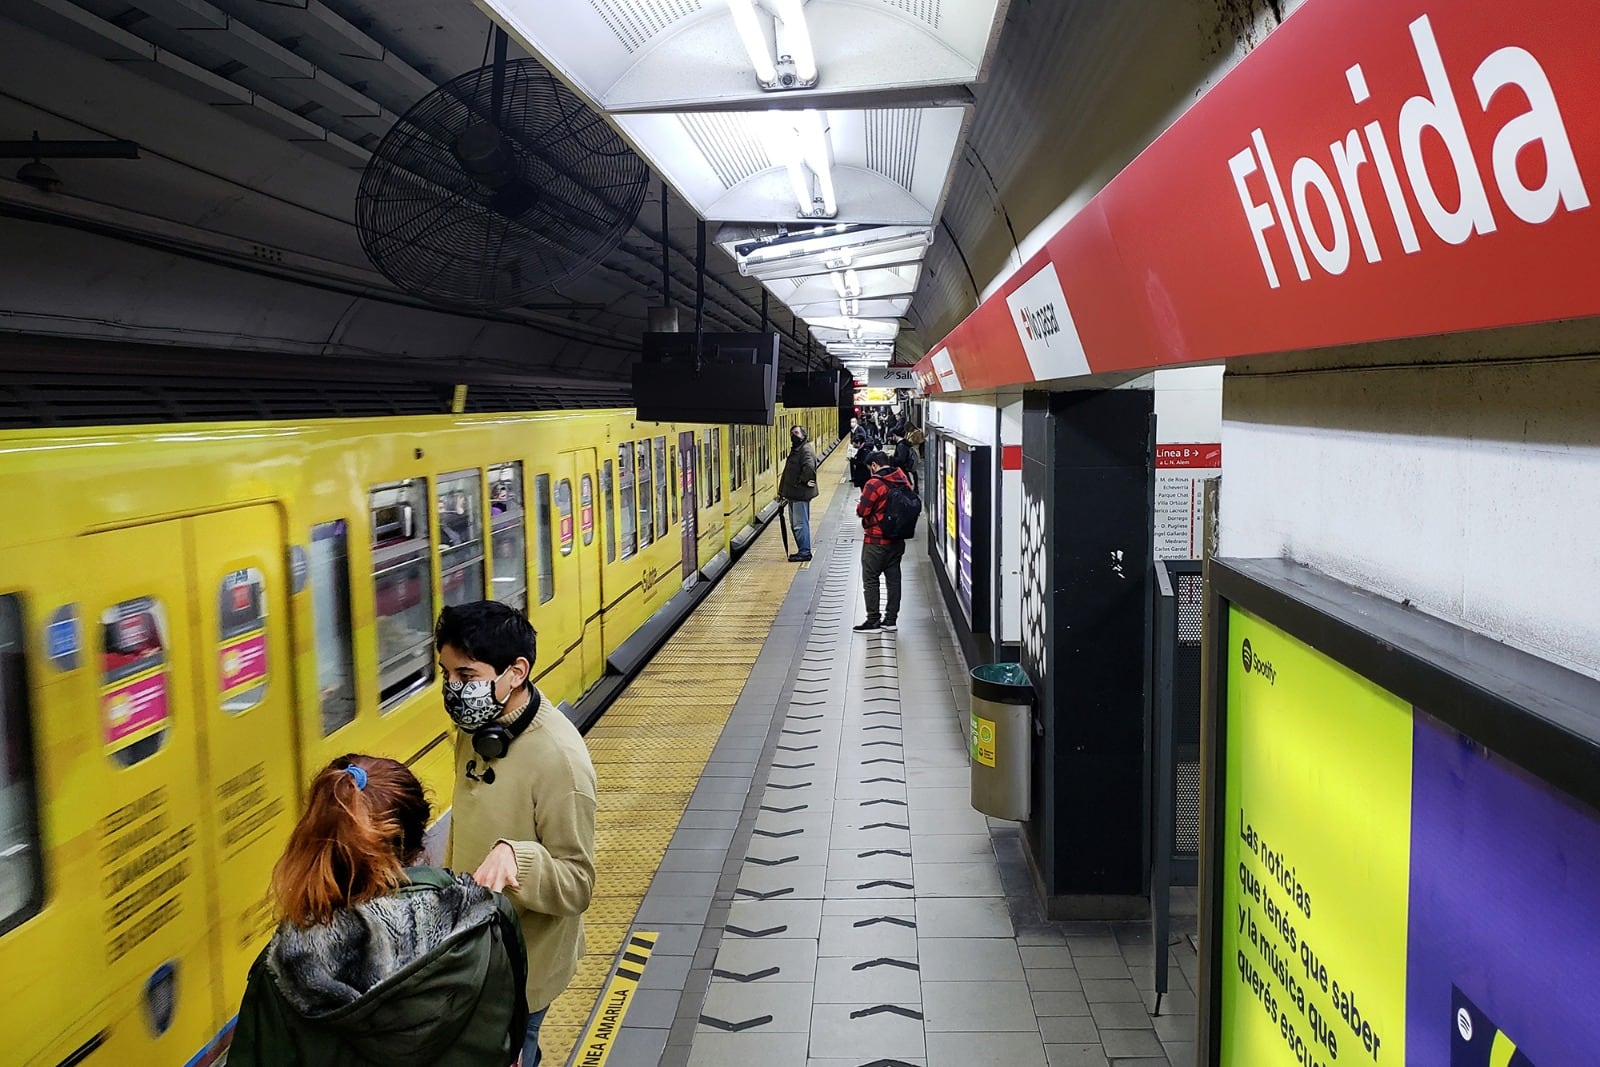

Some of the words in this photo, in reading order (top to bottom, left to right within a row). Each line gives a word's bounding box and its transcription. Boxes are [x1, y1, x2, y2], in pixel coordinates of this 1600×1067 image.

[1228, 13, 1591, 289] Florida
[1036, 301, 1060, 348] pasar
[1156, 448, 1181, 457] Línea
[1183, 448, 1190, 457] B
[1253, 653, 1276, 686] Spotify
[1240, 808, 1258, 855] Las
[1261, 841, 1311, 919] noticias
[595, 989, 630, 1040] AMARILLA
[1237, 949, 1278, 1024] querés
[1280, 1012, 1326, 1067] escu
[1238, 904, 1246, 934] y
[1247, 906, 1257, 948] la
[1259, 932, 1304, 1015] música
[1308, 1002, 1337, 1060] que
[1239, 861, 1260, 904] que
[1262, 884, 1297, 953] tenés
[1300, 940, 1328, 993] que
[1332, 980, 1380, 1063] saber
